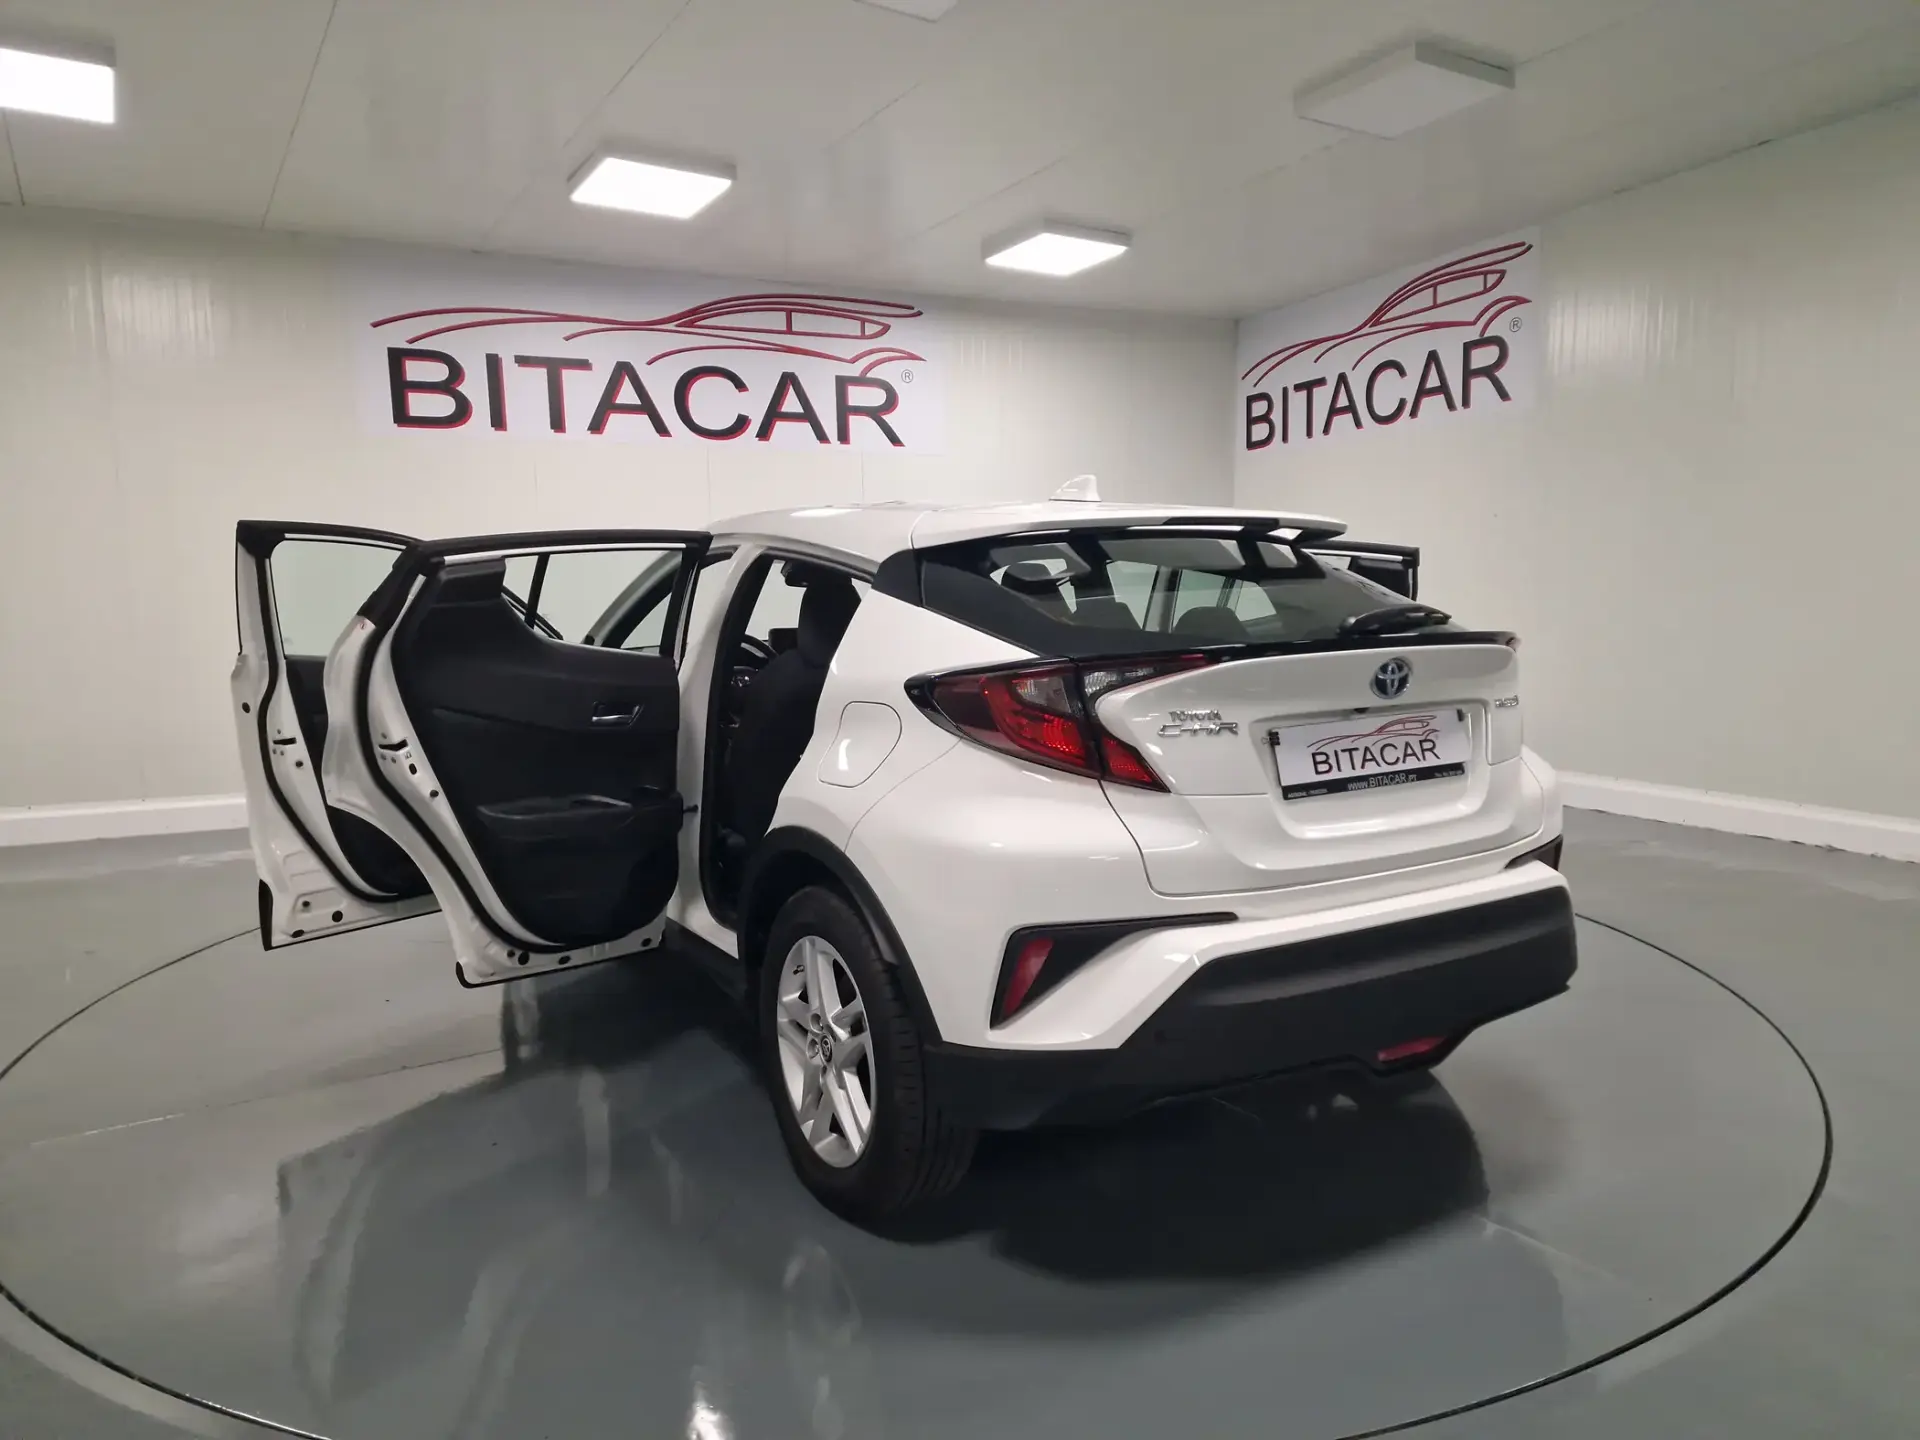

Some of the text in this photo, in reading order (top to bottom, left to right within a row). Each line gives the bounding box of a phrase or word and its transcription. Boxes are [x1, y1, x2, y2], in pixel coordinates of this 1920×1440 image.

[387, 346, 905, 447] BITACAR
[1246, 334, 1512, 451] BITACAR
[1311, 738, 1441, 776] BITACAR
